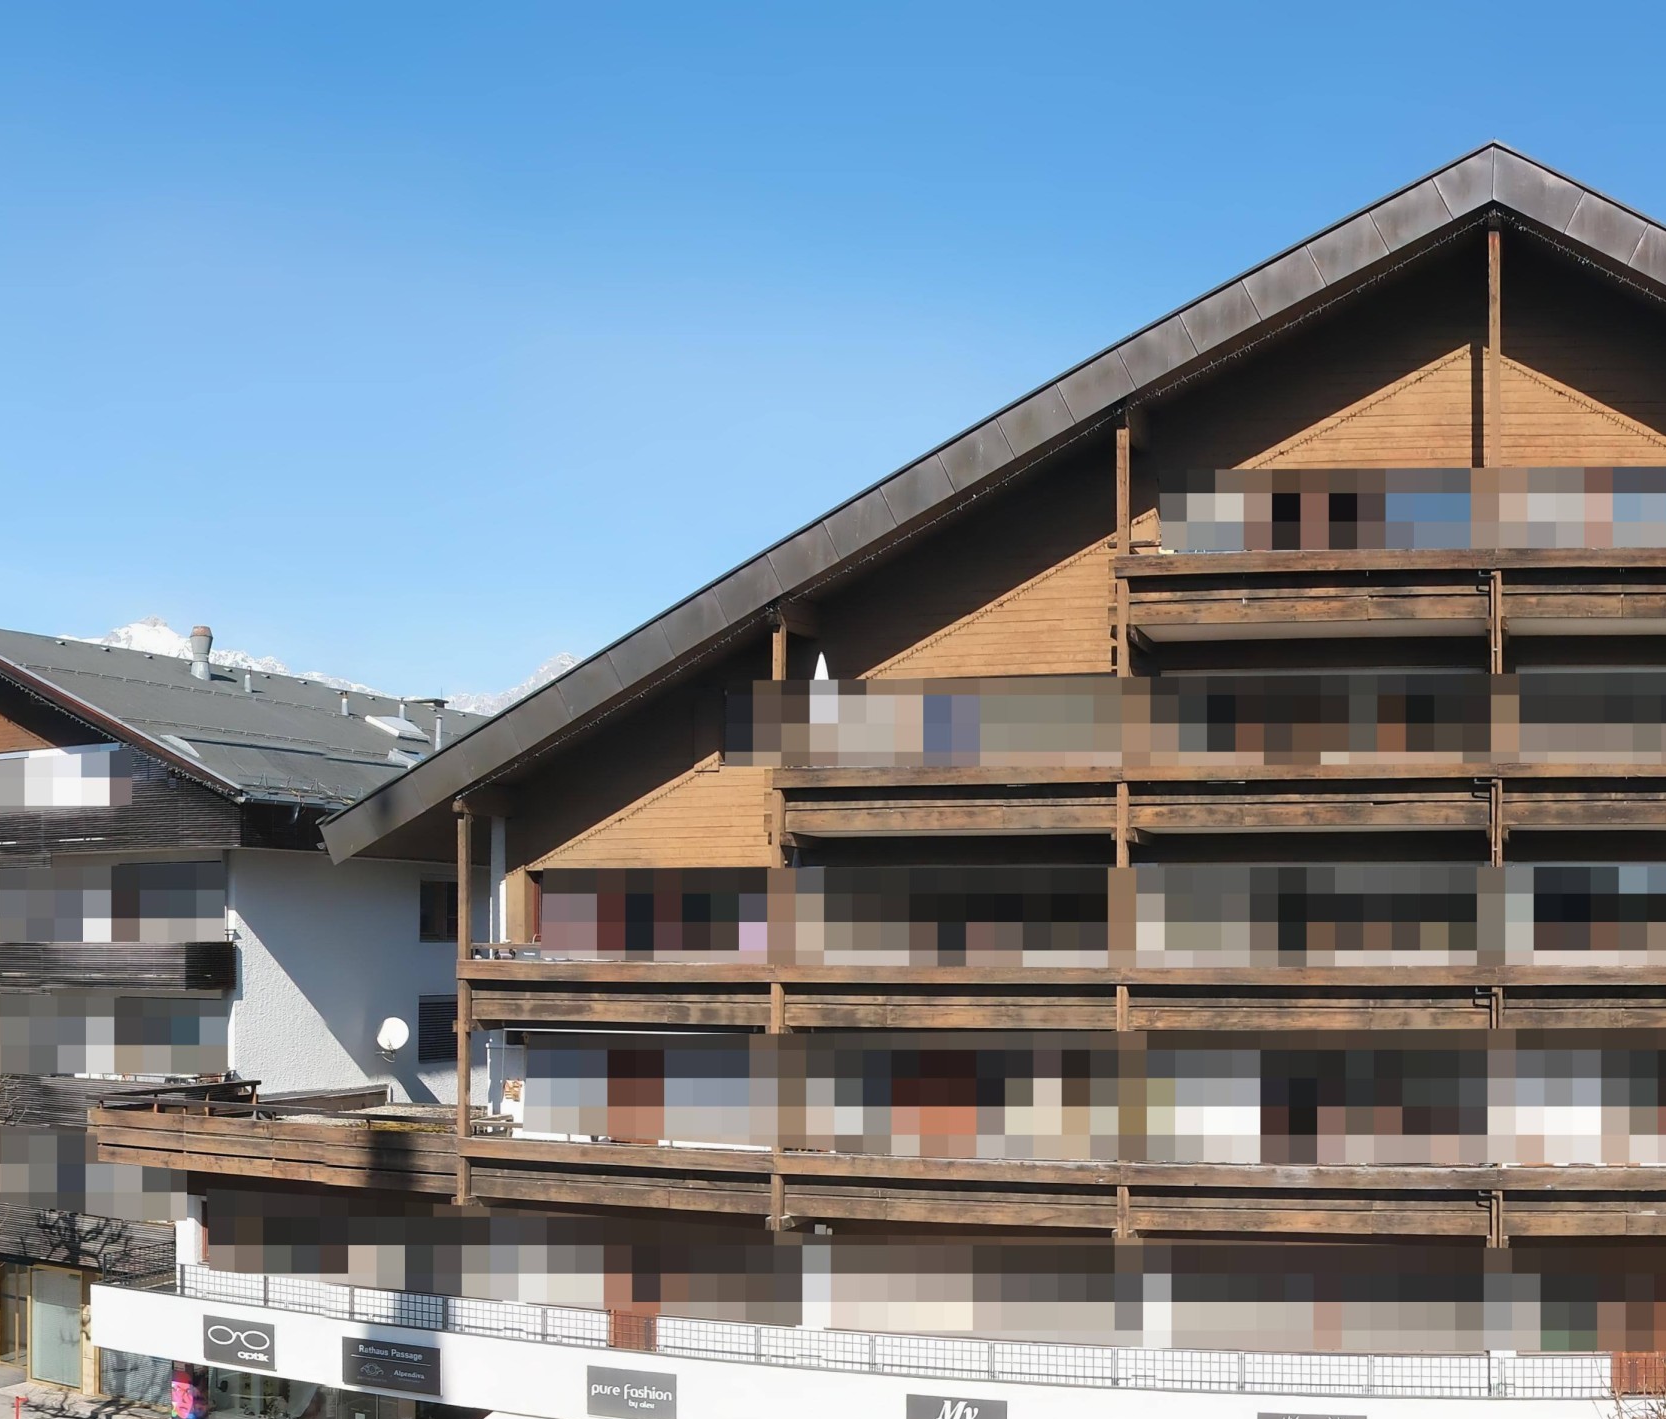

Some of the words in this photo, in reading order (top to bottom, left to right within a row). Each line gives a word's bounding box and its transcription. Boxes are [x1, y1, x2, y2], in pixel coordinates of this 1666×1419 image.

[237, 1350, 269, 1362] optik
[358, 1344, 389, 1356] Rathaus
[391, 1348, 423, 1361] Passage
[393, 1369, 425, 1380] Alpendiva
[591, 1383, 621, 1396] pure
[623, 1383, 672, 1401] fashion
[628, 1399, 638, 1409] by
[639, 1401, 655, 1409] alex
